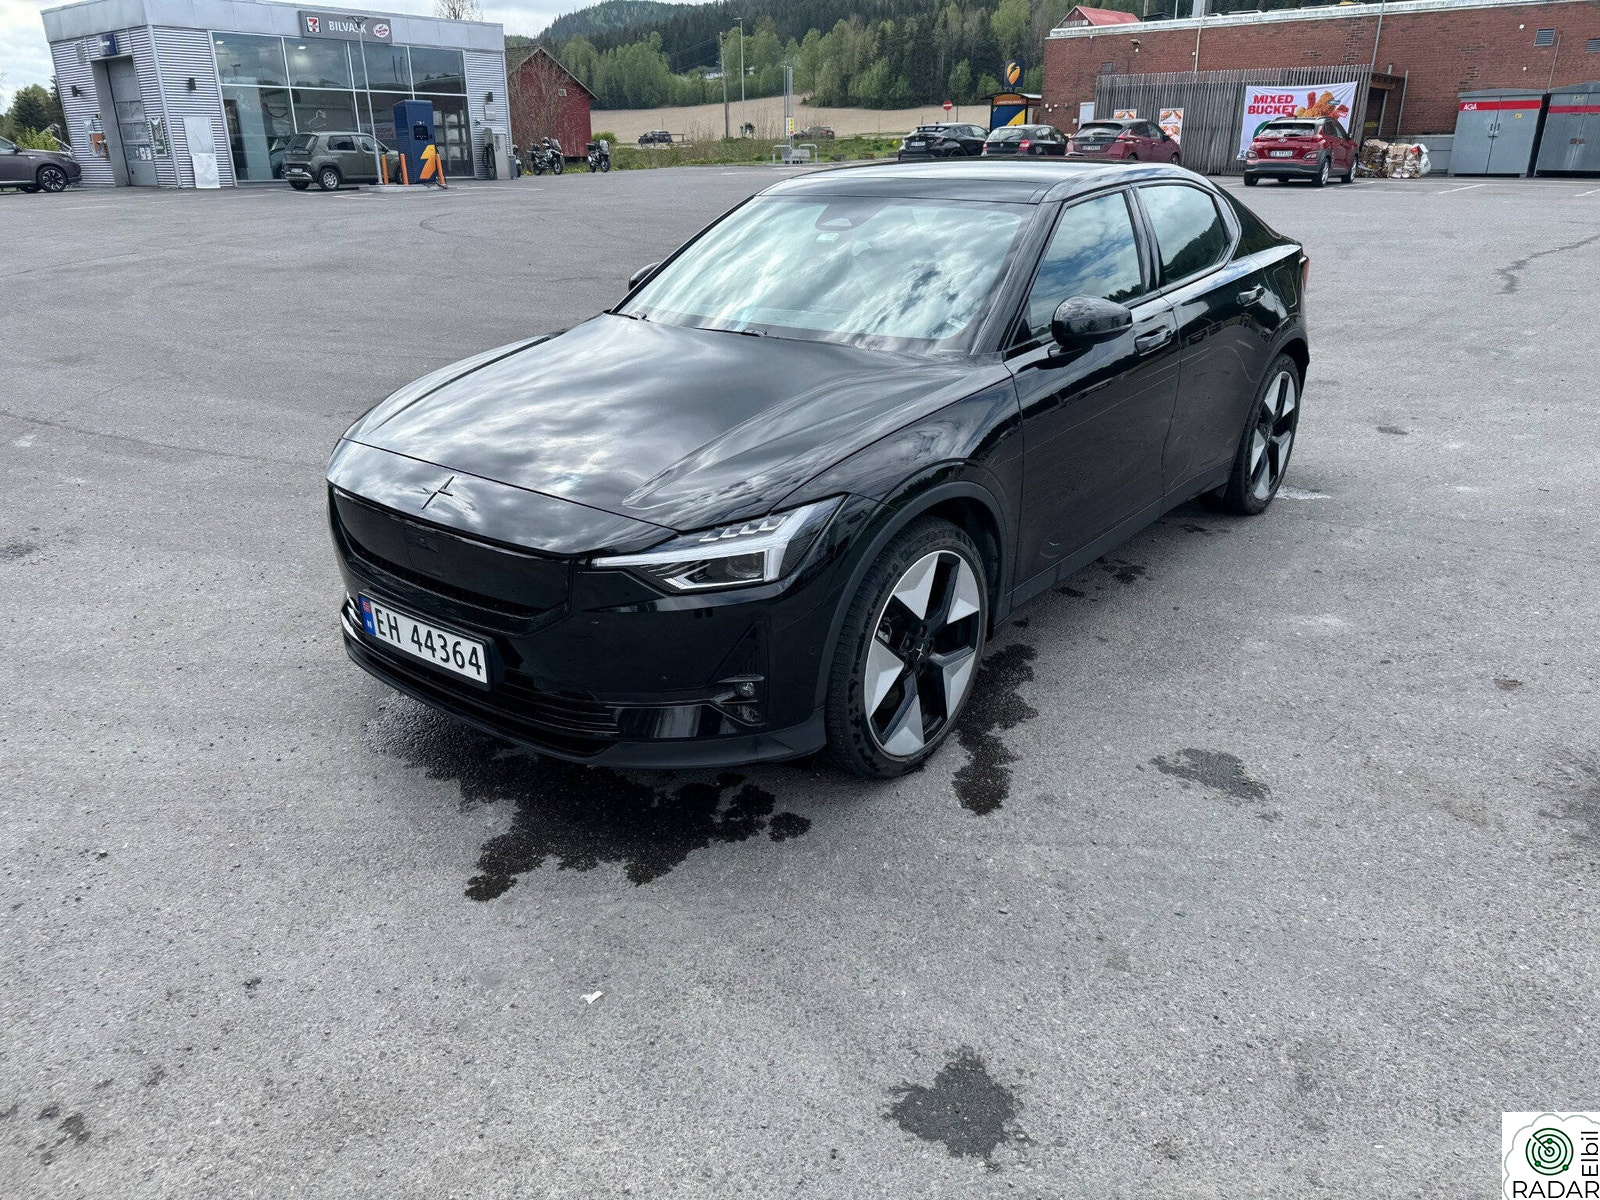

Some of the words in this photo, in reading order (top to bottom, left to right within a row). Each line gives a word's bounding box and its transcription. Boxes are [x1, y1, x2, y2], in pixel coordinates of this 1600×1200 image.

[1253, 95, 1294, 105] MIXED
[1247, 105, 1298, 115] BUCKET
[1463, 103, 1477, 111] AGA
[374, 607, 401, 644] EH
[411, 624, 482, 676] 44364
